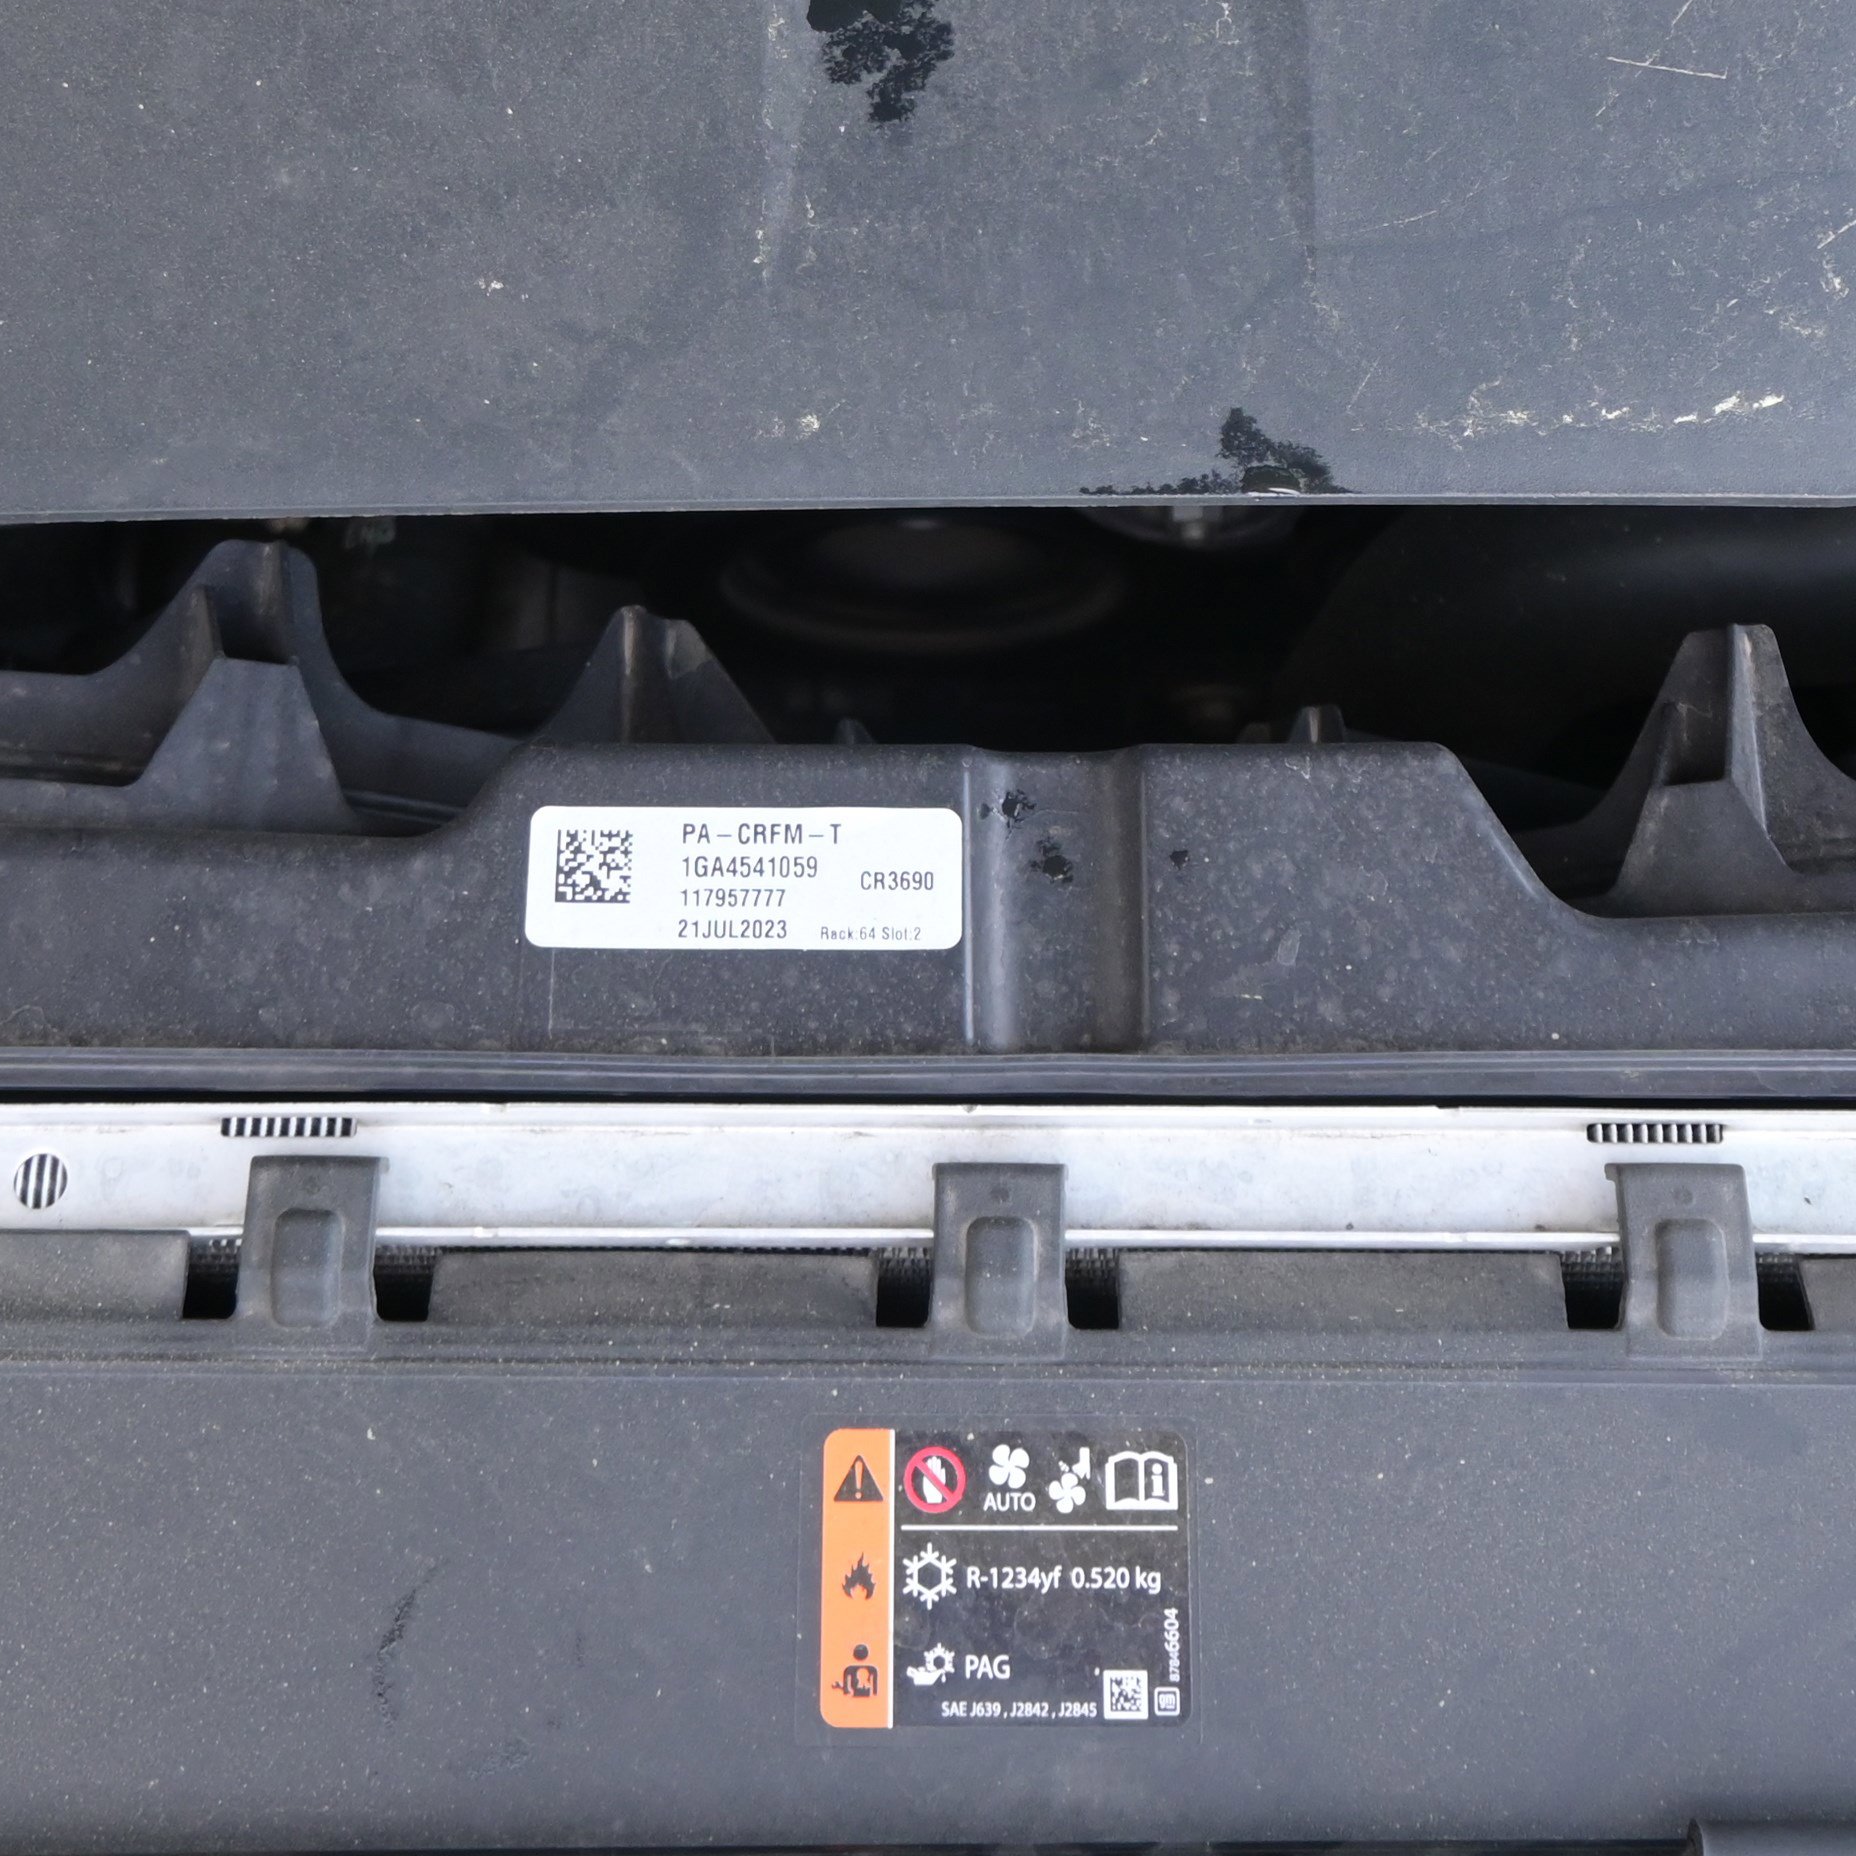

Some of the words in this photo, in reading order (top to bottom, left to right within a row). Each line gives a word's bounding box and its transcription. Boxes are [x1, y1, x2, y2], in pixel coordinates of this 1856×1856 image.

[681, 855, 819, 880] 1GA4541059
[860, 870, 935, 892] CR3690
[679, 888, 786, 908] 117957777
[677, 918, 788, 940] 21JUL2023
[820, 925, 876, 942] Rack:64
[881, 925, 922, 942] Slot:2
[983, 1492, 1036, 1512] AUTO
[966, 1566, 1062, 1594] R-1234yf
[1070, 1566, 1129, 1590] 0.520
[1134, 1566, 1162, 1594] kg
[1164, 1607, 1180, 1682] 87846604
[964, 1654, 1012, 1680] PAG
[941, 1701, 967, 1717] SAE
[1058, 1701, 1097, 1717] J2845
